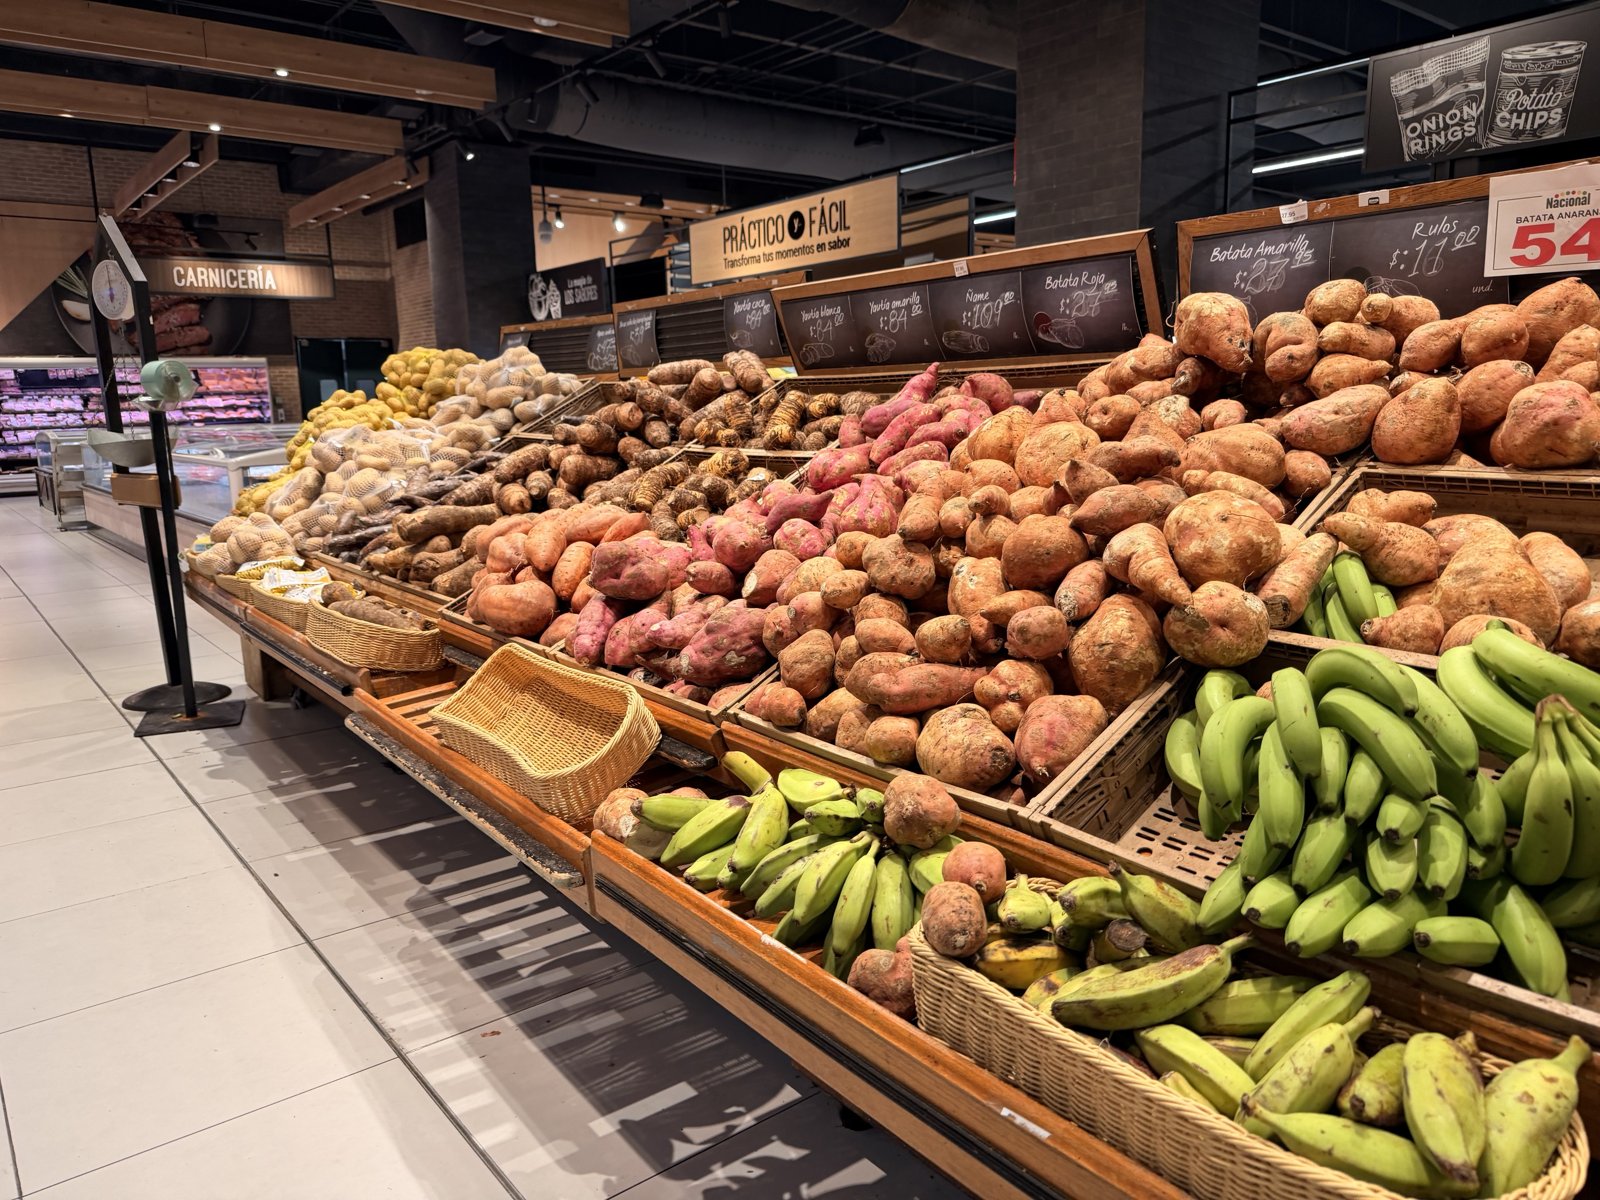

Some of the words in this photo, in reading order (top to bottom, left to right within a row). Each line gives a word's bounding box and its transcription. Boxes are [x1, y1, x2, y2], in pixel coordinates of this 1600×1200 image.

[1503, 87, 1564, 111] Potato
[1406, 102, 1478, 137] ONION
[1496, 108, 1563, 130] CHIPS
[1409, 122, 1476, 154] RINGS
[1546, 193, 1591, 209] Nacional
[723, 215, 785, 254] PRÁCTICO
[809, 197, 850, 238] FÁCIL
[1412, 216, 1458, 240] Rulos
[1516, 213, 1555, 224] BATATA
[1557, 208, 1600, 220] ANARAN
[723, 254, 761, 269] Transforma
[763, 252, 773, 262] tus
[775, 244, 814, 260] momentos
[816, 242, 826, 253] en
[828, 236, 850, 251] sabor
[1210, 243, 1253, 262] Batata
[1254, 233, 1309, 258] Amarilla
[173, 265, 277, 290] CARNICERÍA
[1045, 273, 1079, 290] Batata
[1081, 271, 1105, 294] Roja
[891, 291, 920, 309] amarilla
[966, 288, 990, 302] Ñame
[821, 305, 841, 317] blanca
